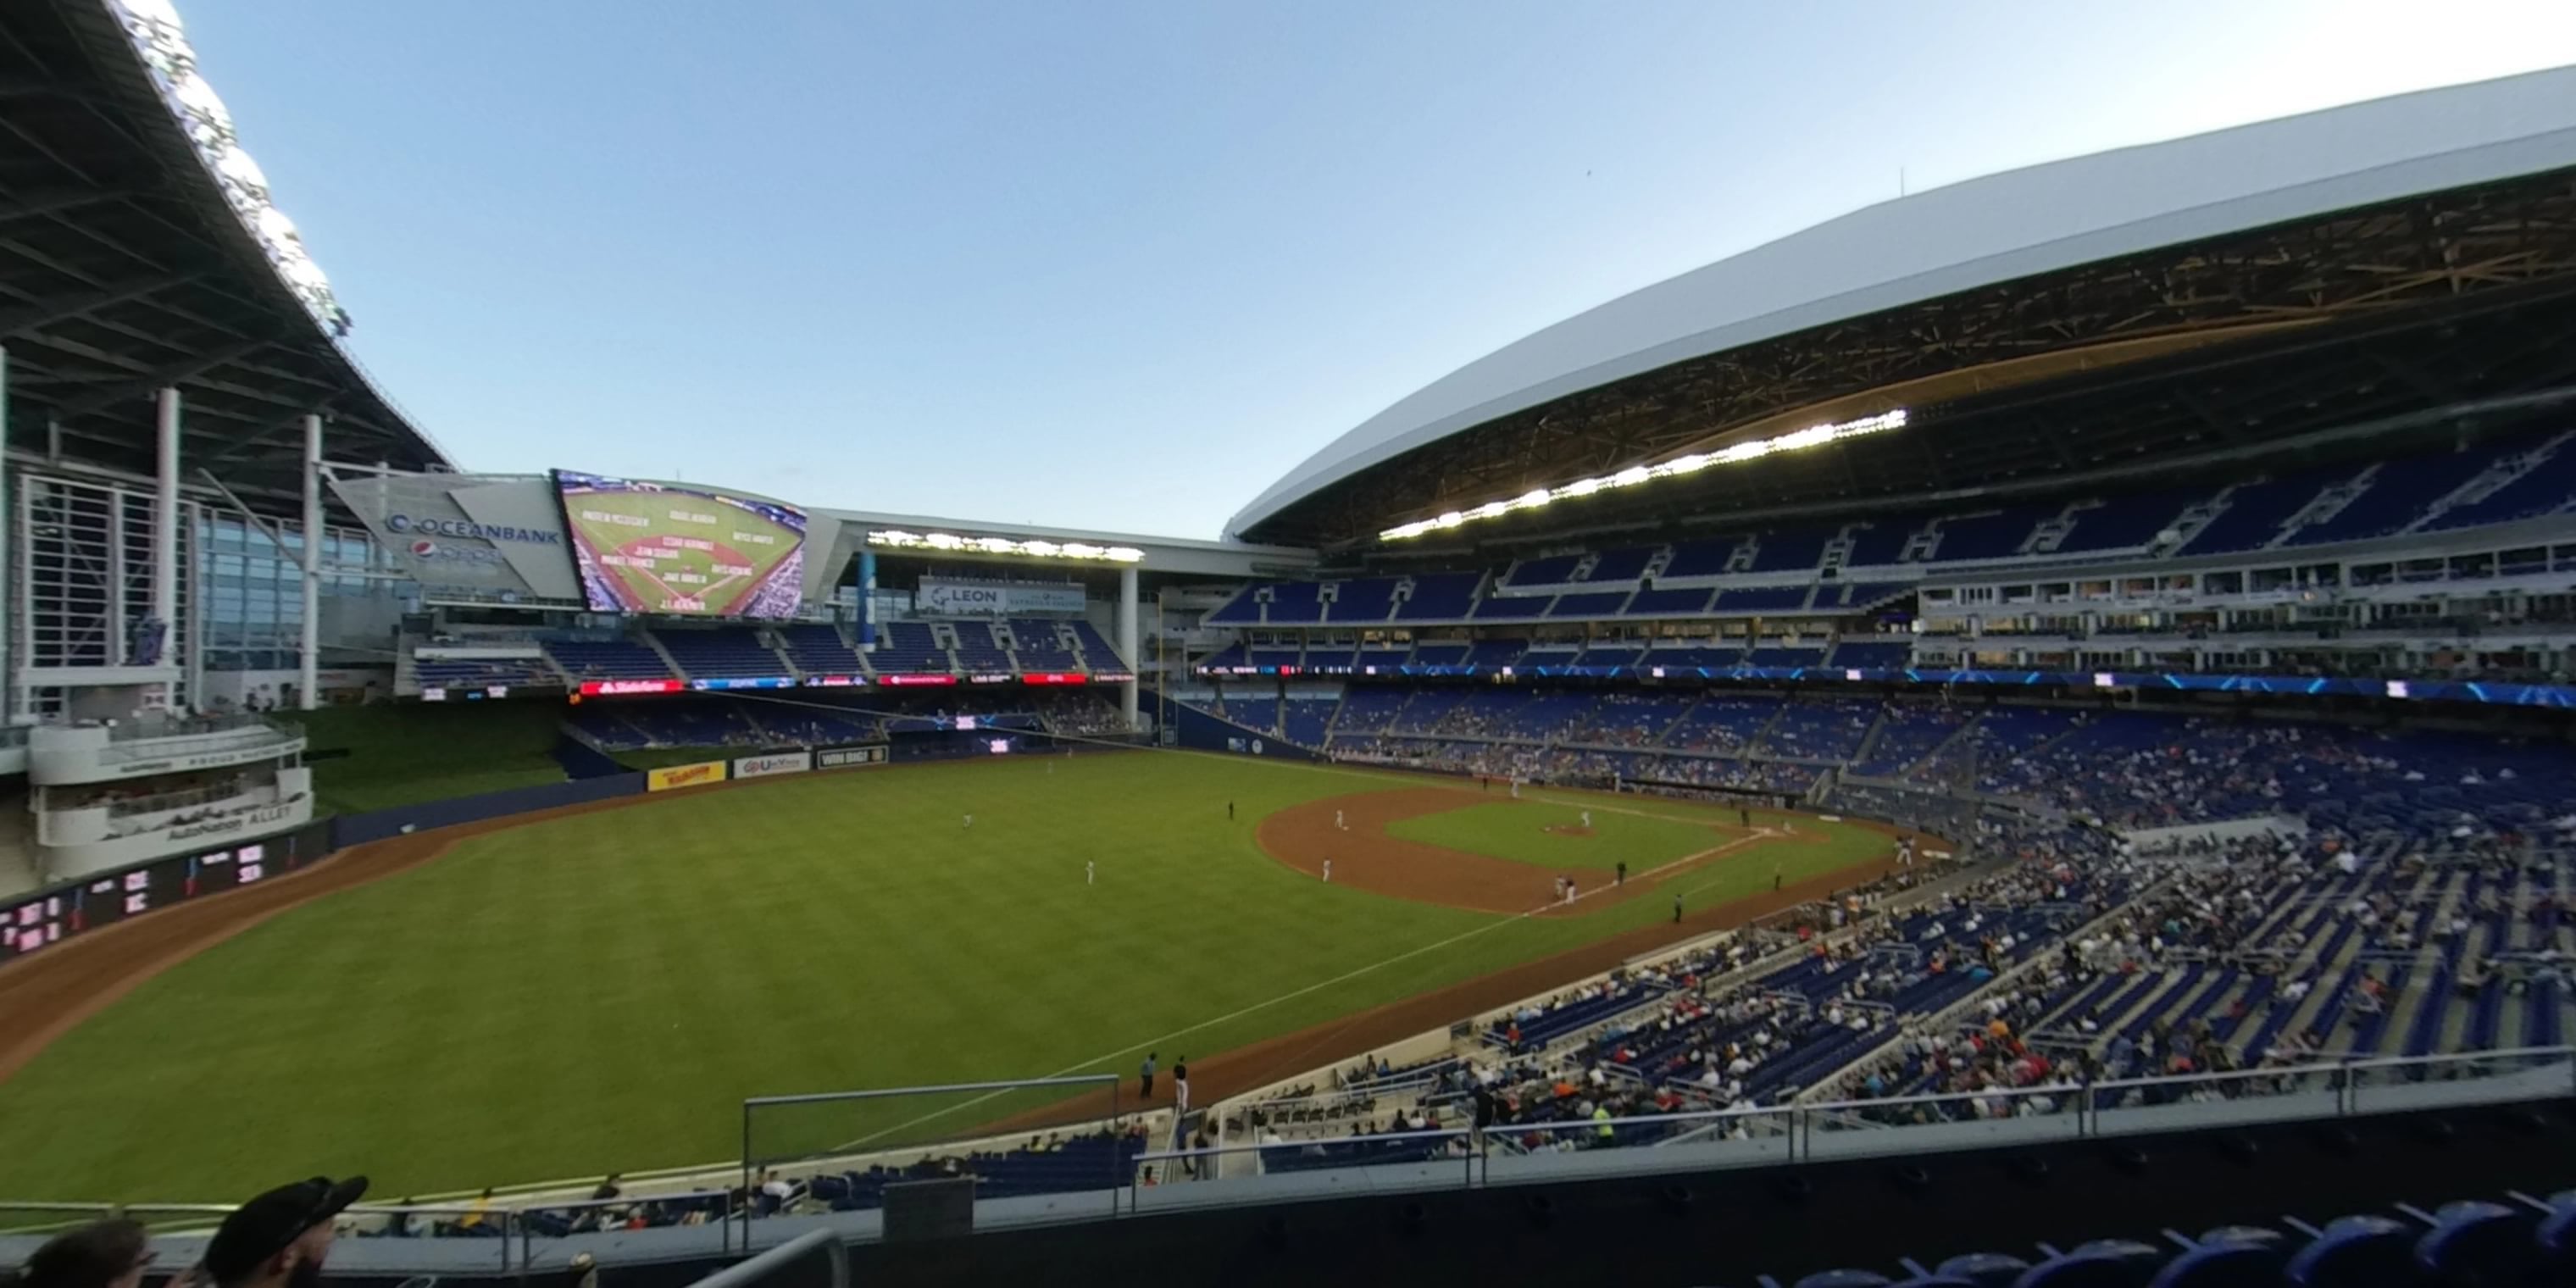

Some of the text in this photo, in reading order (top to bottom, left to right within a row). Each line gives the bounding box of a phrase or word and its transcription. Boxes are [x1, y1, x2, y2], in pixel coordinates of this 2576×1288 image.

[420, 519, 559, 544] OCEANBANK
[952, 590, 997, 602] LEON
[822, 752, 846, 766] WIN
[168, 806, 292, 841] AutoNation ALLEY
